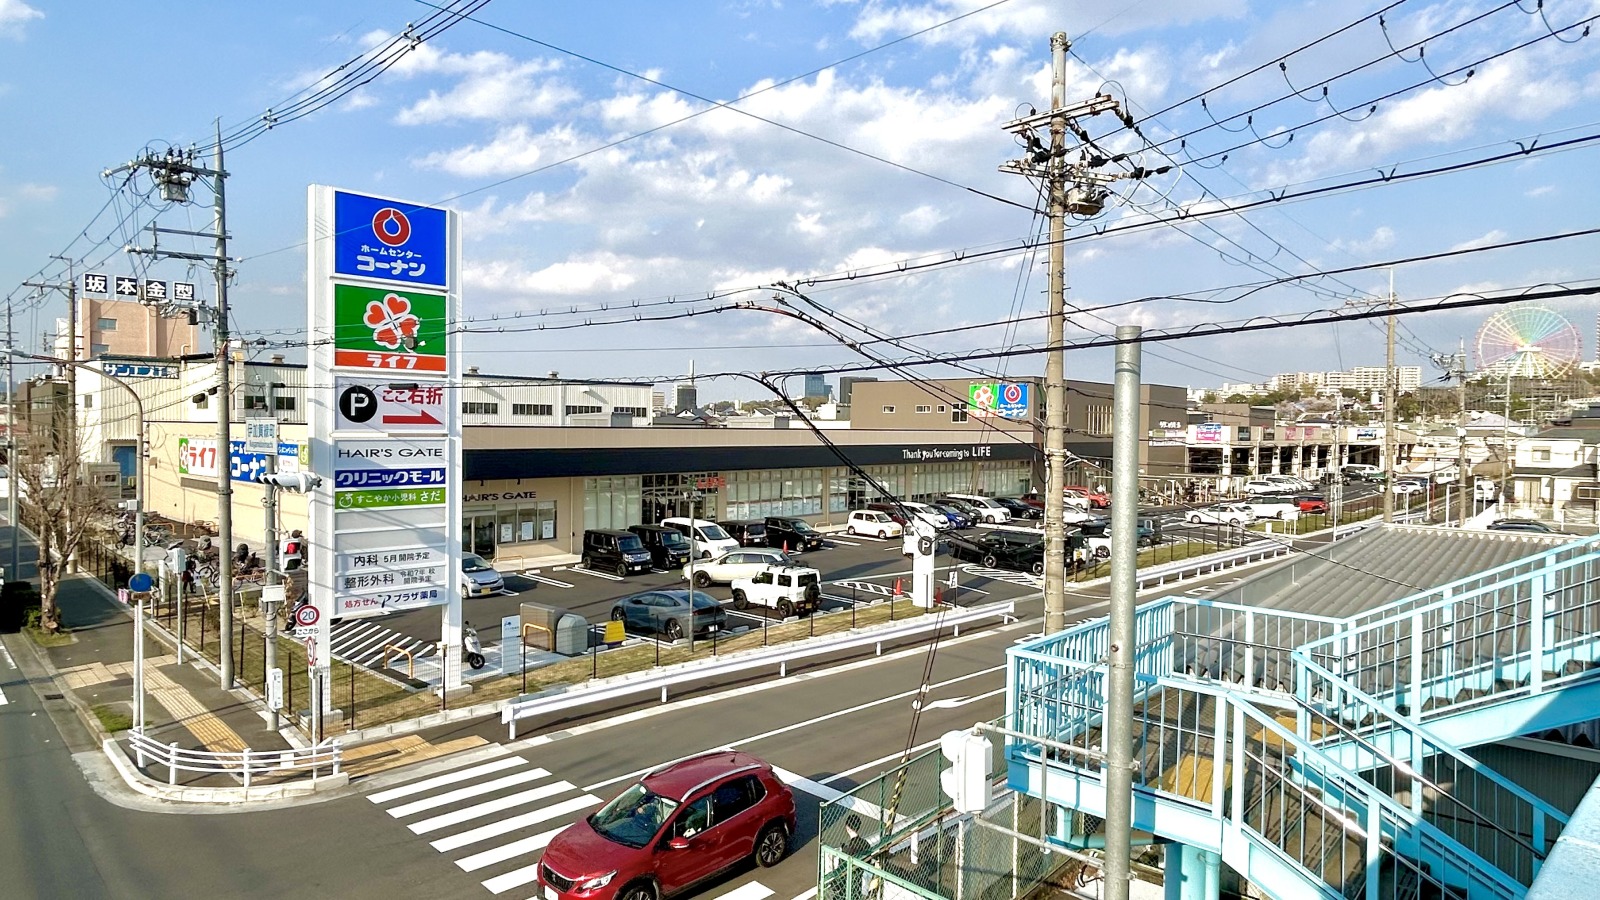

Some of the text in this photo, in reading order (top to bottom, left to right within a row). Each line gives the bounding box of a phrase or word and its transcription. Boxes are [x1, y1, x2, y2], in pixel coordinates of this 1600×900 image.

[361, 244, 422, 259] ホームセンター
[356, 255, 426, 277] コーナン
[86, 274, 193, 300] 坂本金型
[366, 353, 418, 369] ライフ
[189, 446, 216, 468] ライフ
[338, 449, 443, 459] HAIR'S GATE
[902, 449, 921, 459] Thank
[972, 446, 991, 457] LIFE
[336, 470, 444, 486] クリニックモール
[356, 491, 441, 504] すこやか小児科 さだ
[502, 491, 536, 499] GATE
[354, 554, 378, 567] 内科
[344, 573, 394, 589] 整形外科
[344, 598, 378, 609] 処方せん
[393, 590, 438, 603] プラザ薬局
[302, 610, 315, 621] 20
[297, 627, 320, 636] ここから
